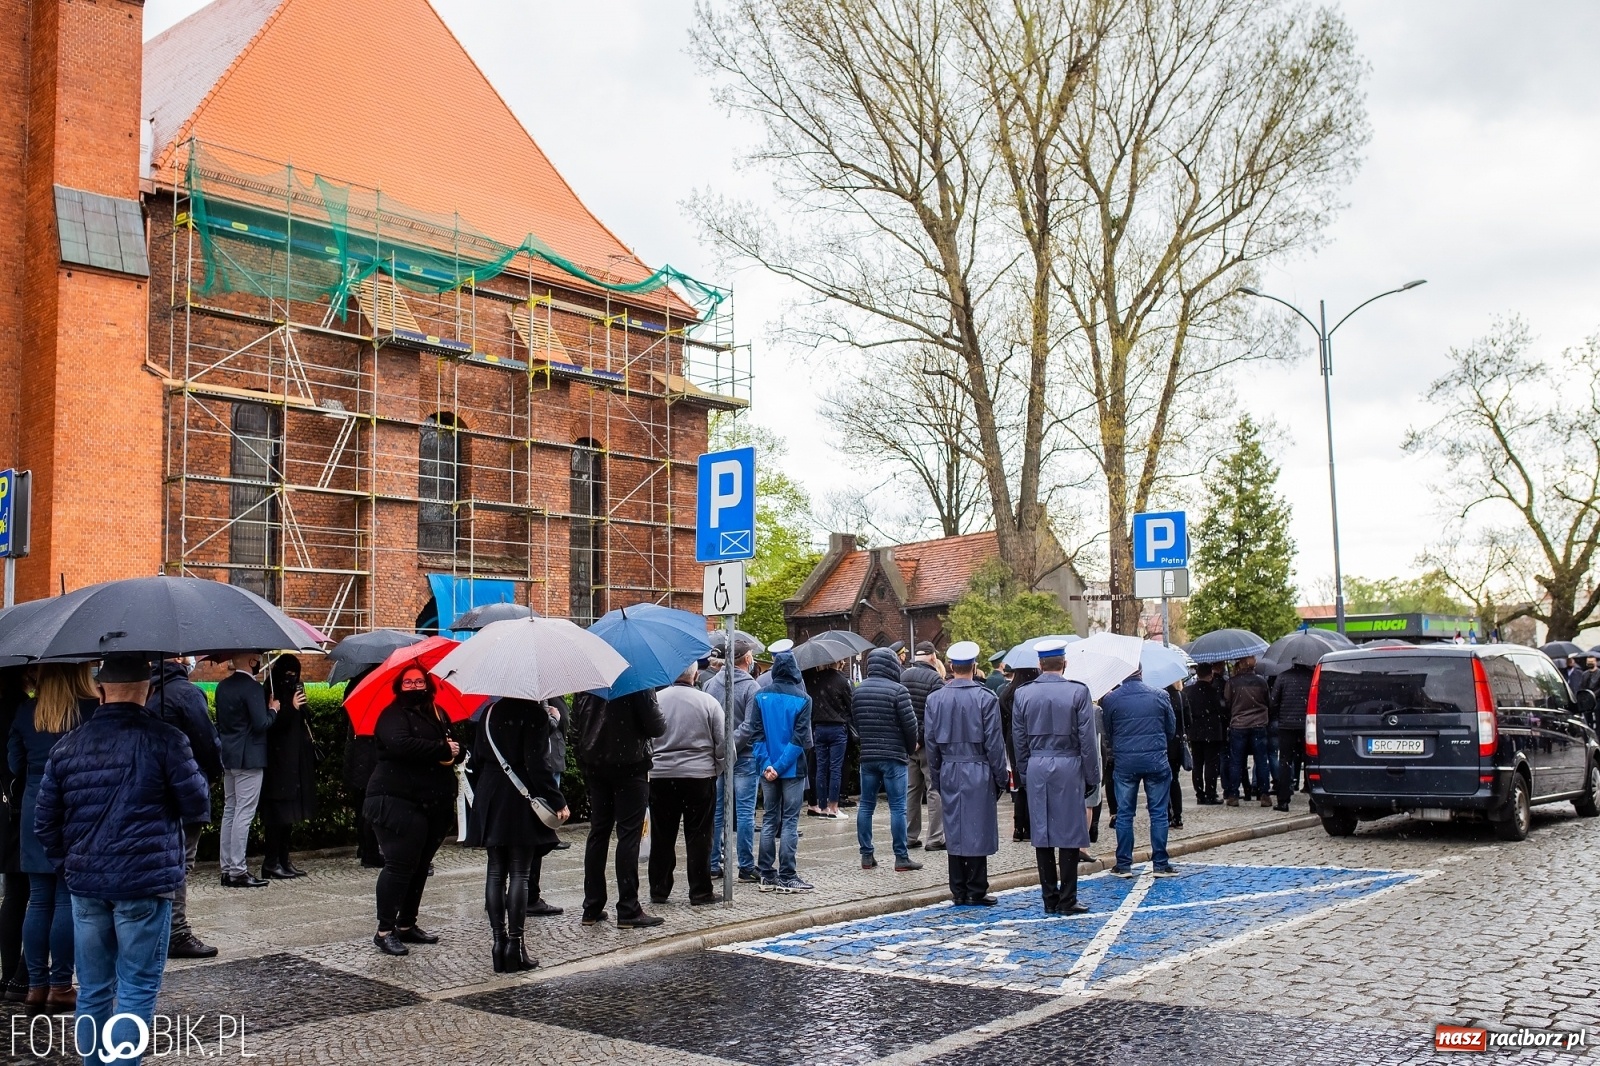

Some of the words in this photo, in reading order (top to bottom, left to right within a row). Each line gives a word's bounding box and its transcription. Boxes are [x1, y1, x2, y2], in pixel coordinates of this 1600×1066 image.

[710, 460, 742, 528] P
[1146, 518, 1175, 562] P
[1373, 619, 1407, 631] RUCH
[1374, 740, 1393, 750] SRC
[1396, 740, 1421, 750] 7PR9
